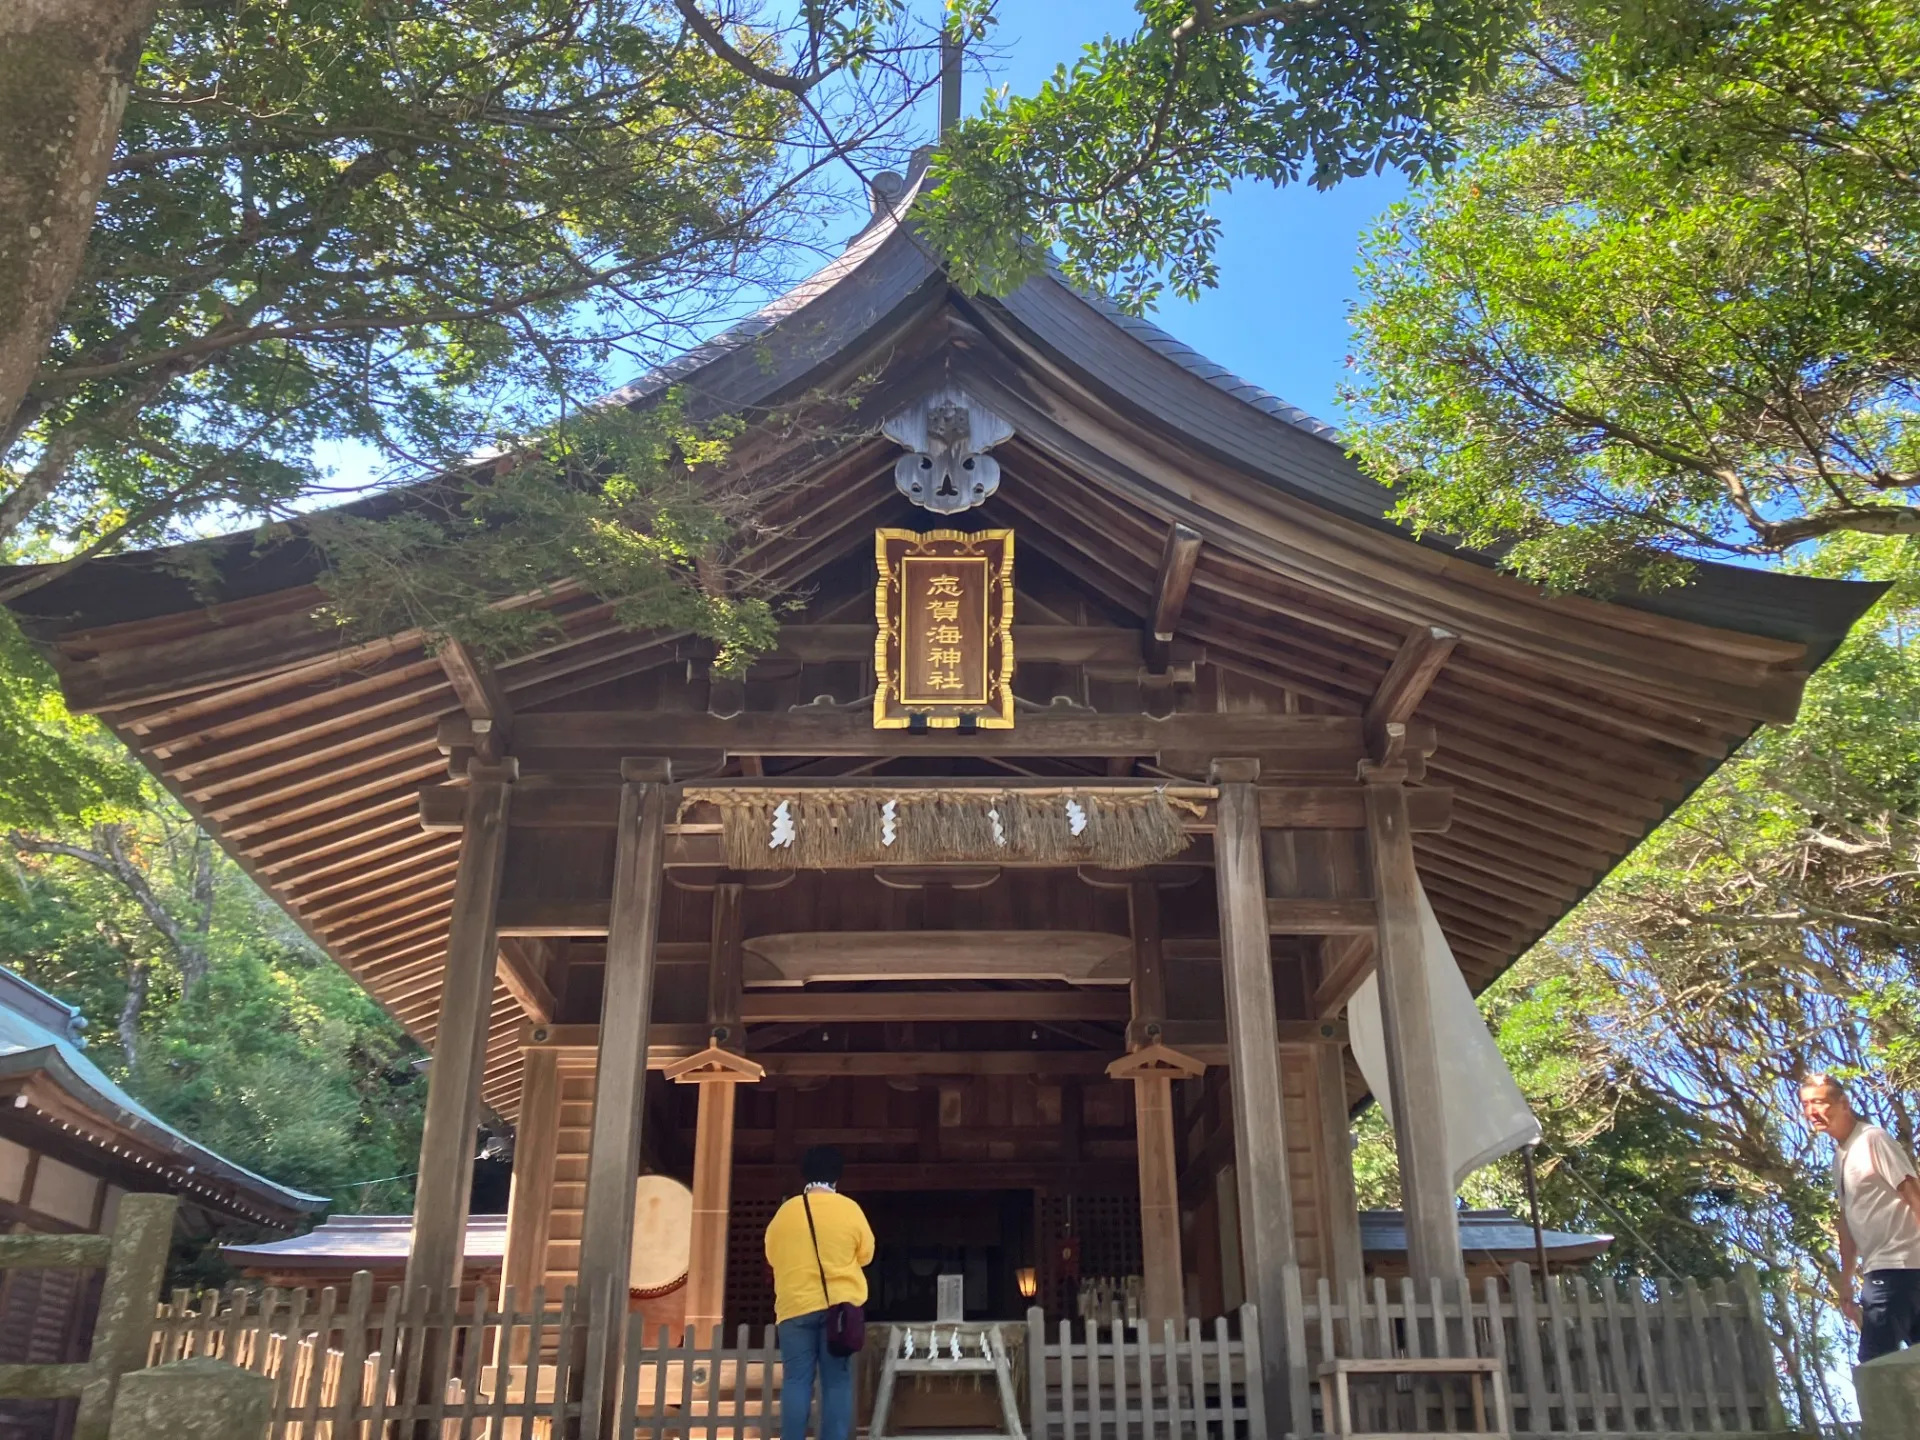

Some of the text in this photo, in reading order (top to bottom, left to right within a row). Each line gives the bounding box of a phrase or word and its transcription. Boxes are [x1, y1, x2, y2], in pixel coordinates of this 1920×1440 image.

[925, 573, 964, 690] 志賀海神社
